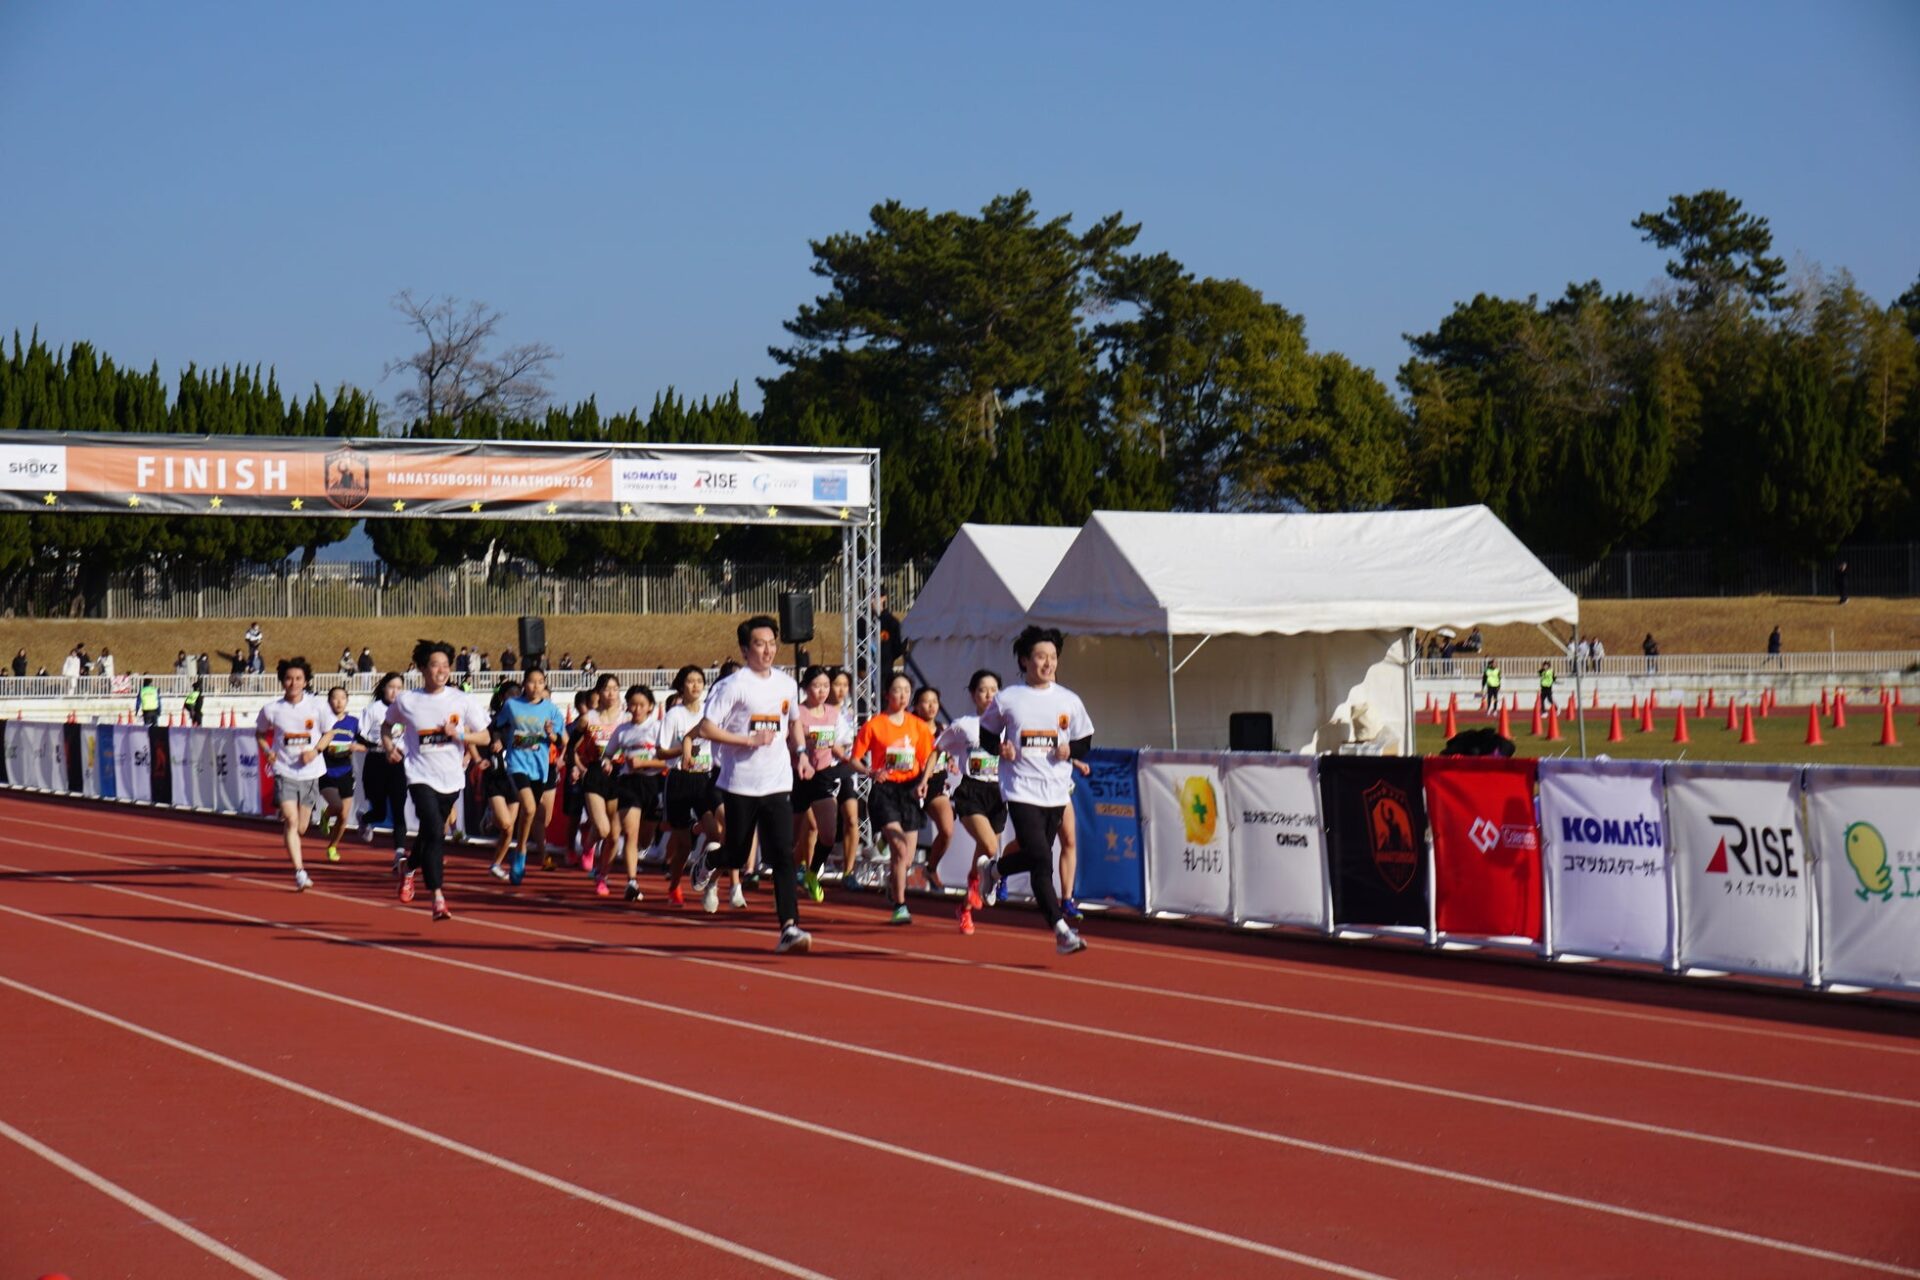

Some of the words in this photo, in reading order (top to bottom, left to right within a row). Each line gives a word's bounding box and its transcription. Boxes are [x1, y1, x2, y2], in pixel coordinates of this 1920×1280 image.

[8, 461, 58, 475] SHOKZ
[136, 456, 288, 490] FINISH
[622, 470, 678, 481] KOMATSU
[386, 472, 487, 487] NANATSUBOSHI
[491, 474, 594, 489] MARATHON2026
[693, 470, 738, 489] RISE
[1561, 813, 1662, 848] KOMATSU
[1705, 815, 1799, 879] RISE
[1724, 879, 1798, 898] ライズマットレス
